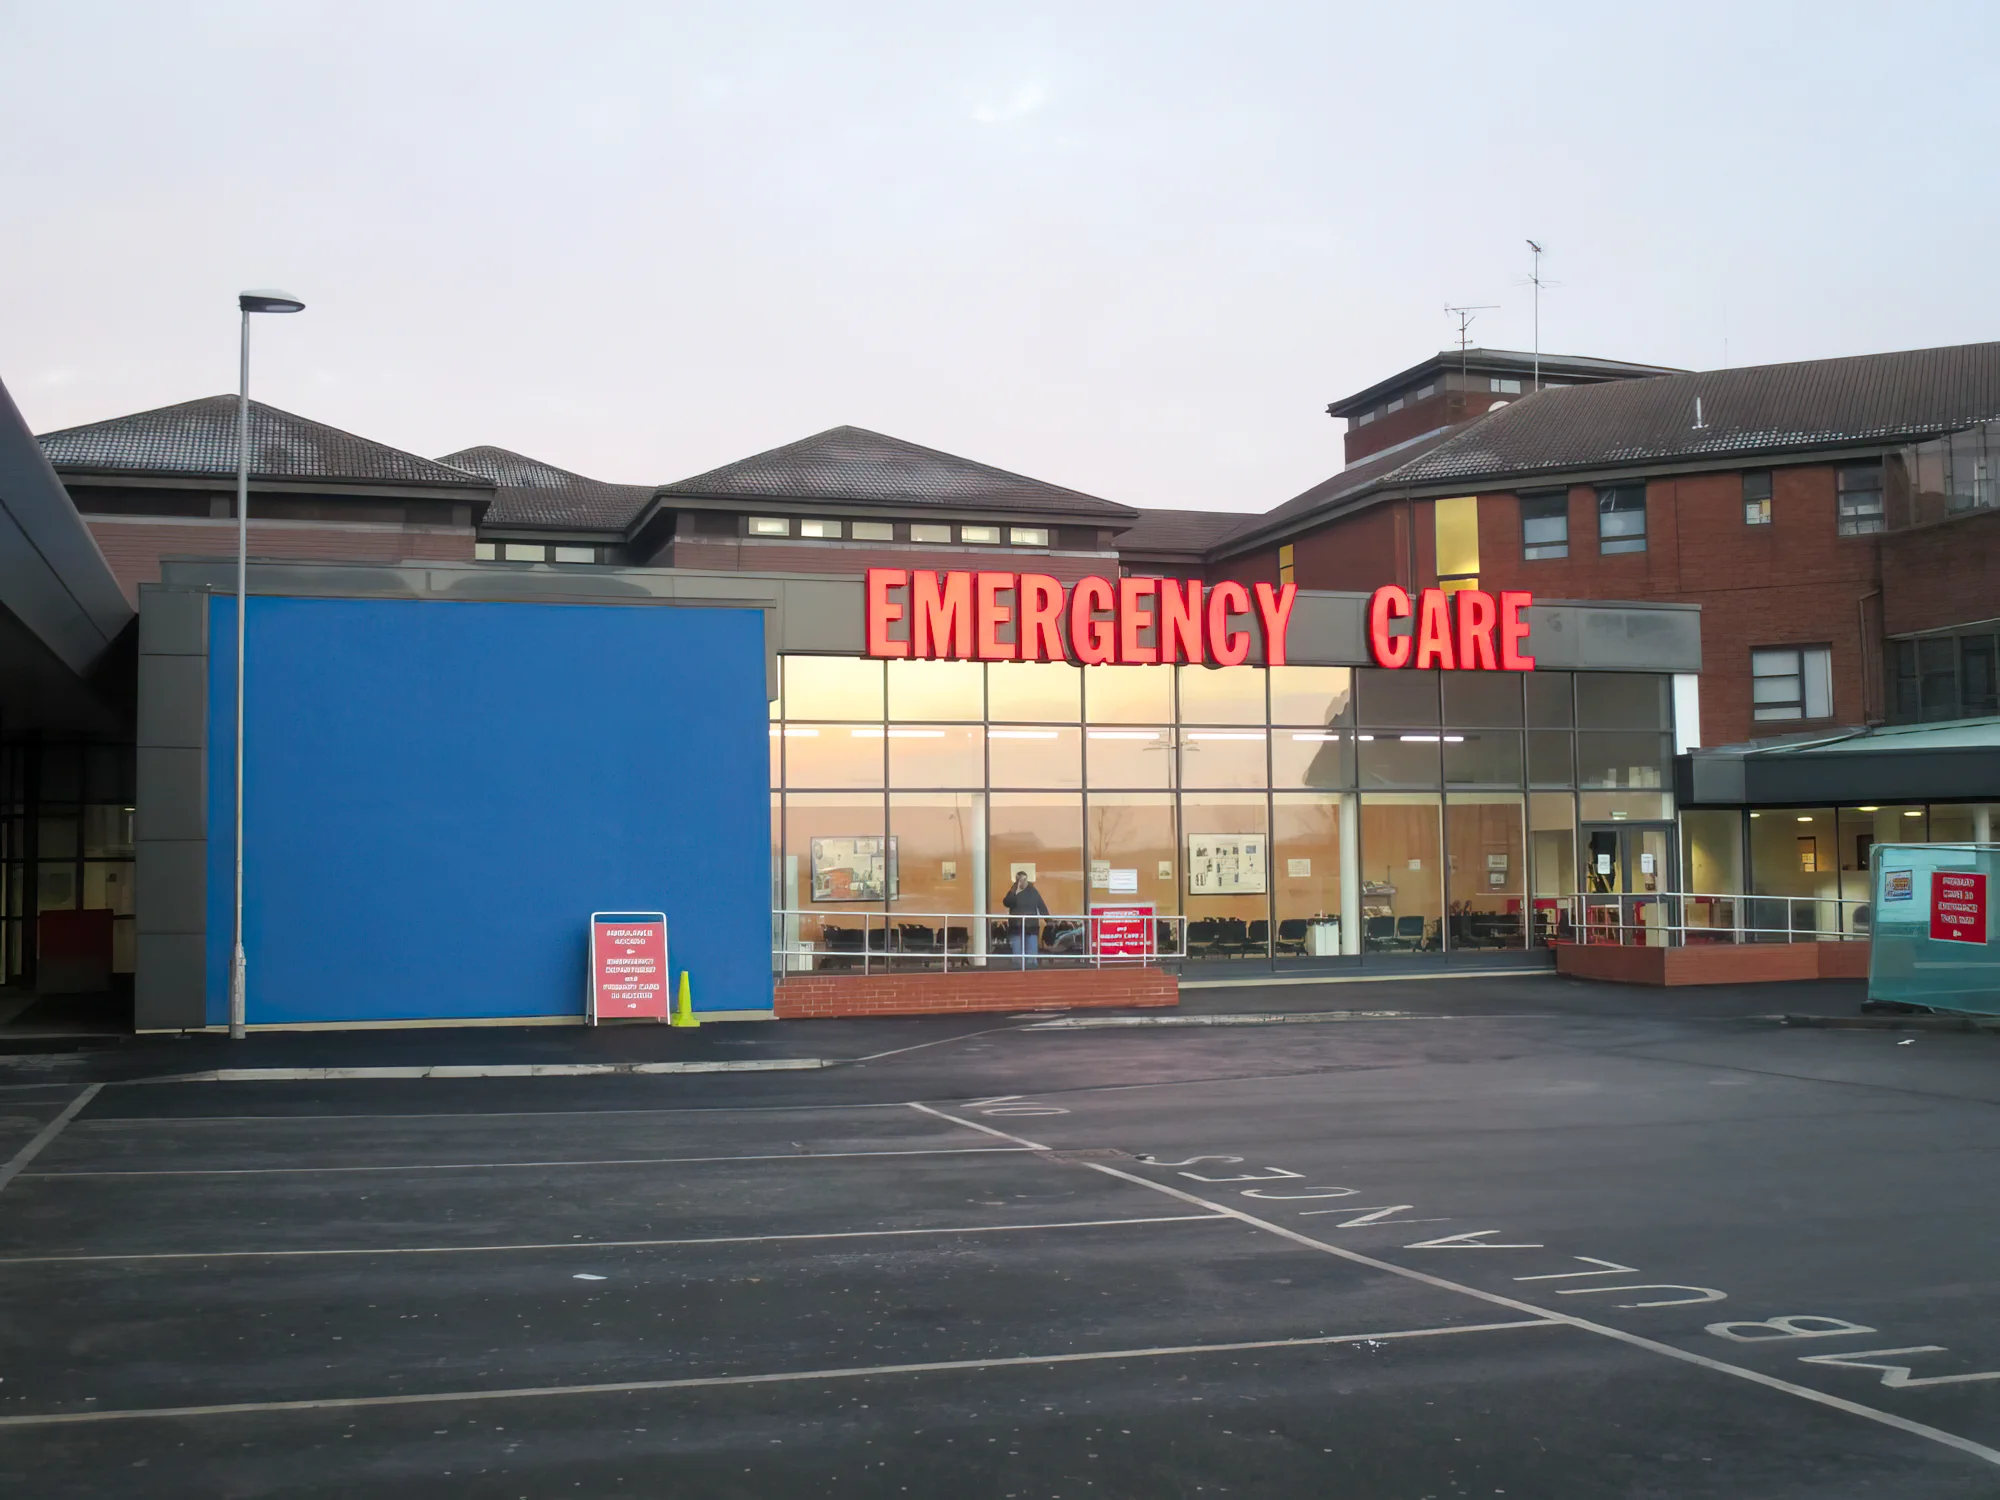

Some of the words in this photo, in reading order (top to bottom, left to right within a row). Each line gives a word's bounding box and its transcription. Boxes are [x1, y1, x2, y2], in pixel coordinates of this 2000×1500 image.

[866, 567, 1299, 667] EMERGENCY
[1368, 585, 1536, 671] CARE
[1141, 1154, 2000, 1387] MBULANCES
